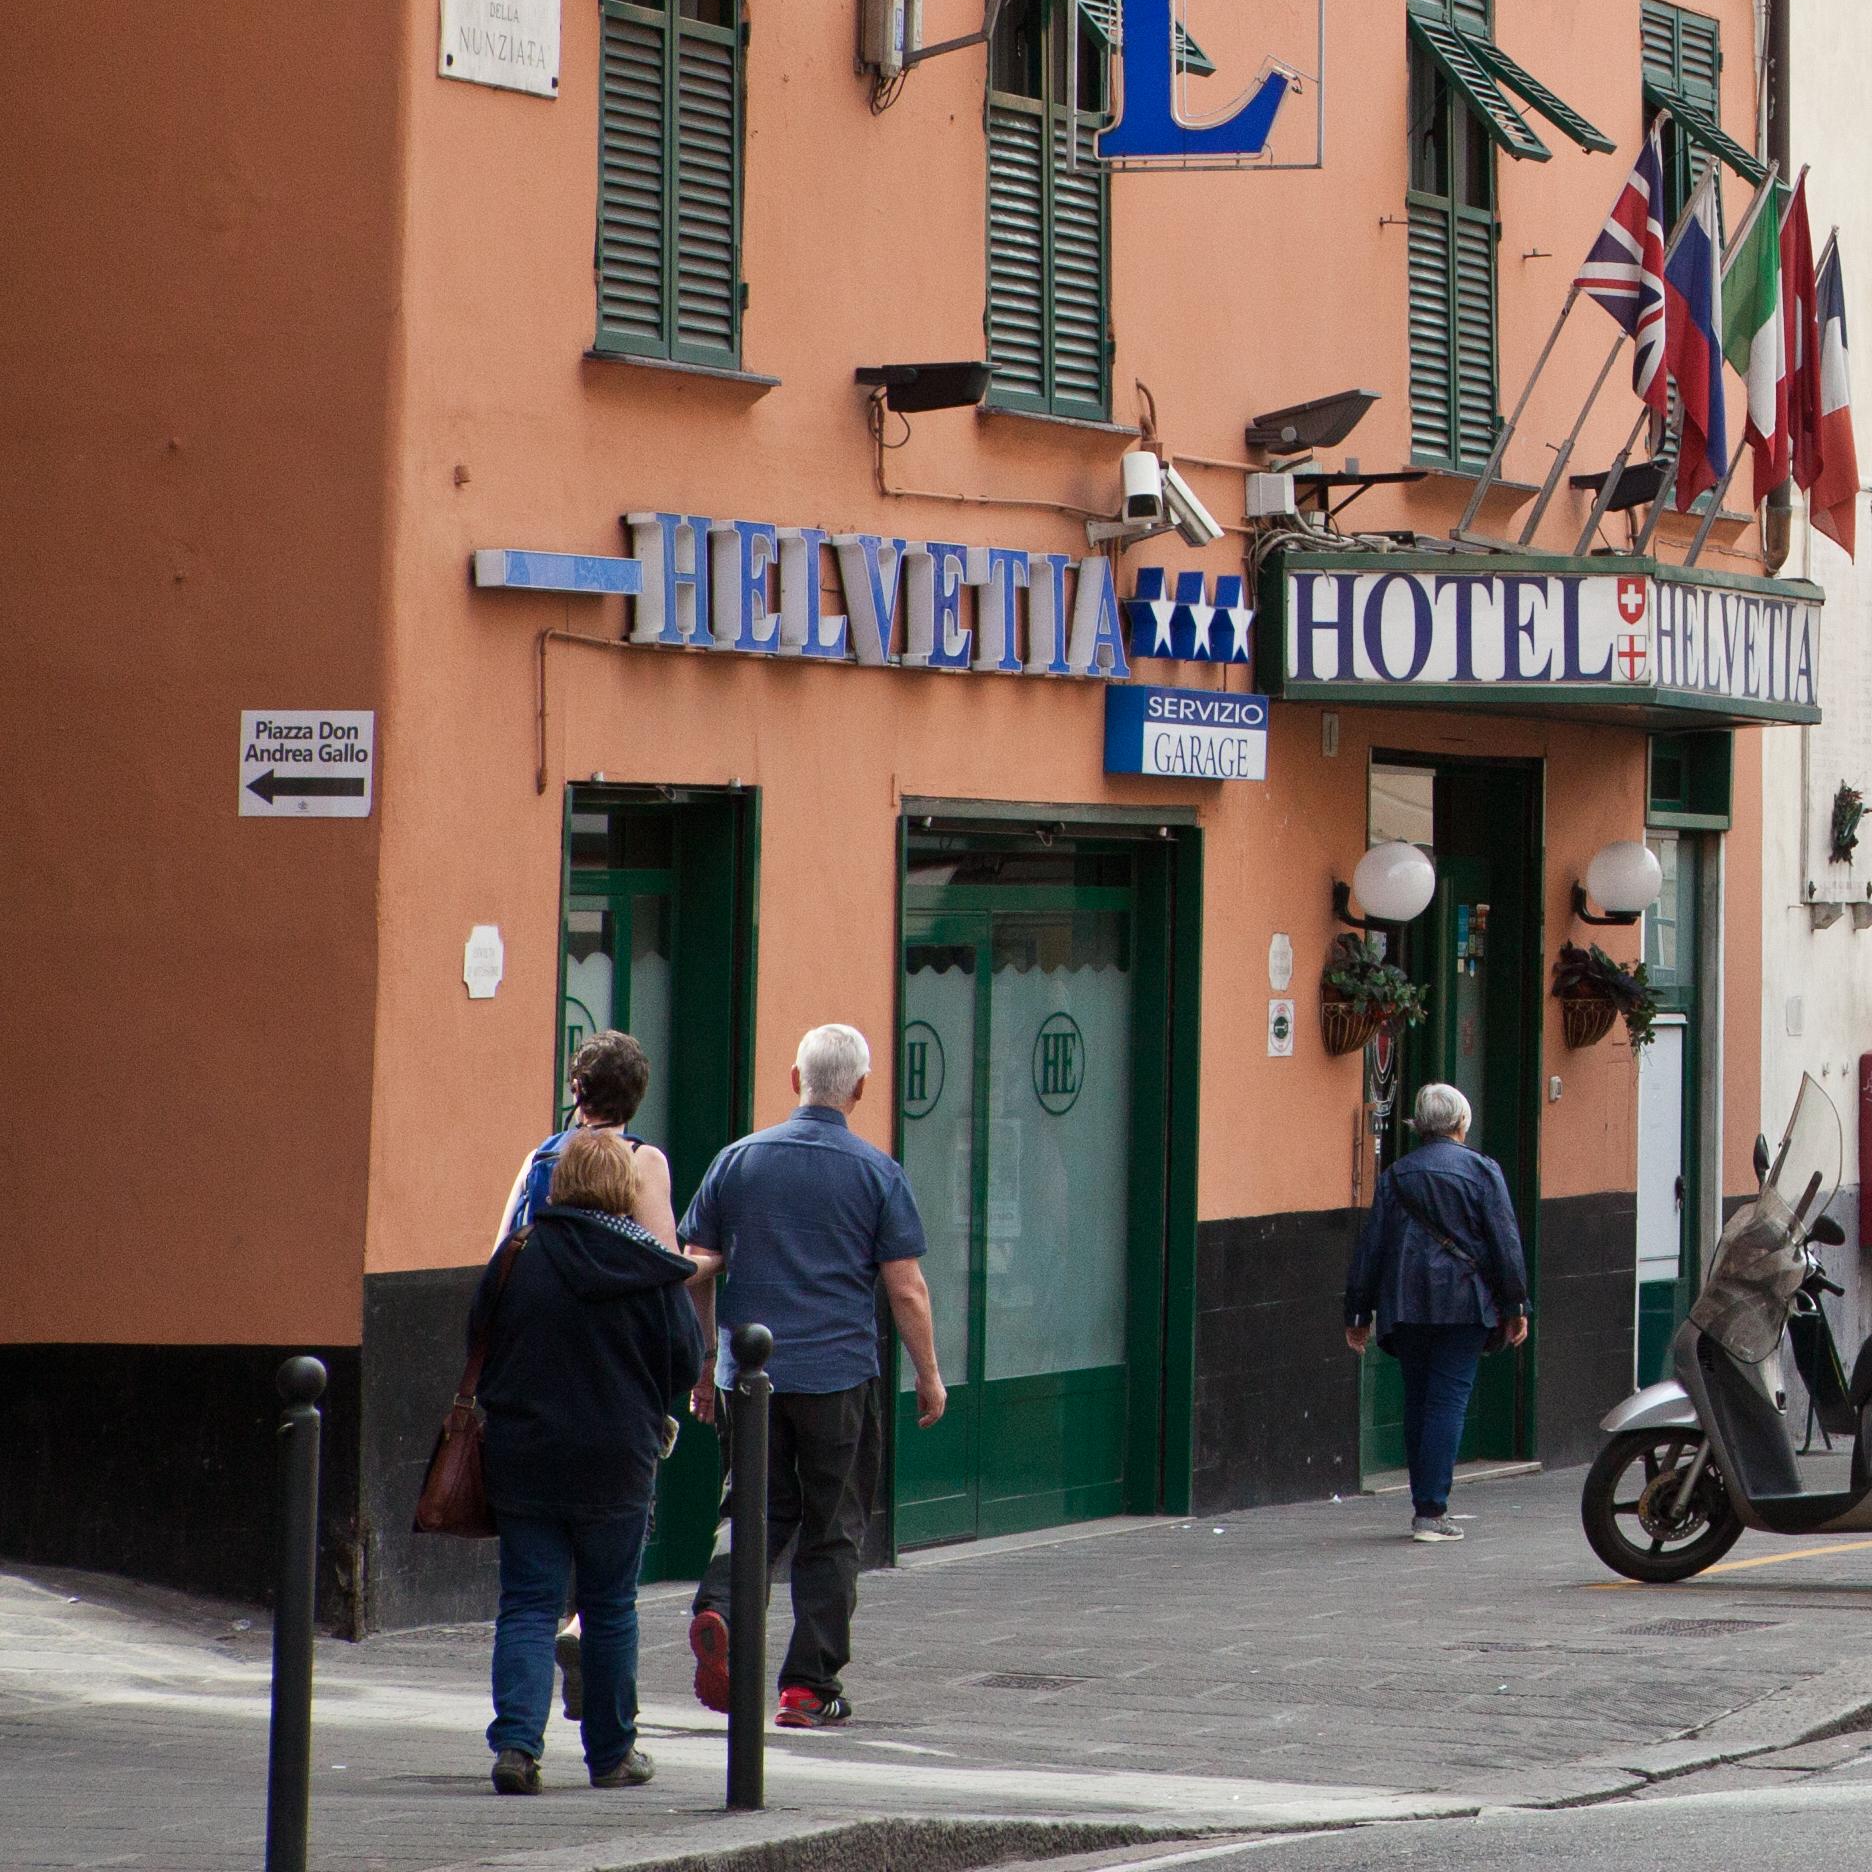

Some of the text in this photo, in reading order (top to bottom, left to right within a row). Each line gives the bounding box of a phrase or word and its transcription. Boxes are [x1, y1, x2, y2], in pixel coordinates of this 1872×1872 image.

[489, 2, 520, 23] DELLA
[459, 26, 546, 69] NUNZIATA
[632, 511, 1131, 679] HELVETIA
[1289, 571, 1816, 706] HOTEL HELVETIA
[255, 720, 359, 740] Piazza Don
[1148, 696, 1264, 725] SERVIZIO
[244, 743, 368, 763] Andrea Gallo
[1154, 732, 1249, 778] GARAGE
[1041, 1031, 1076, 1096] HE
